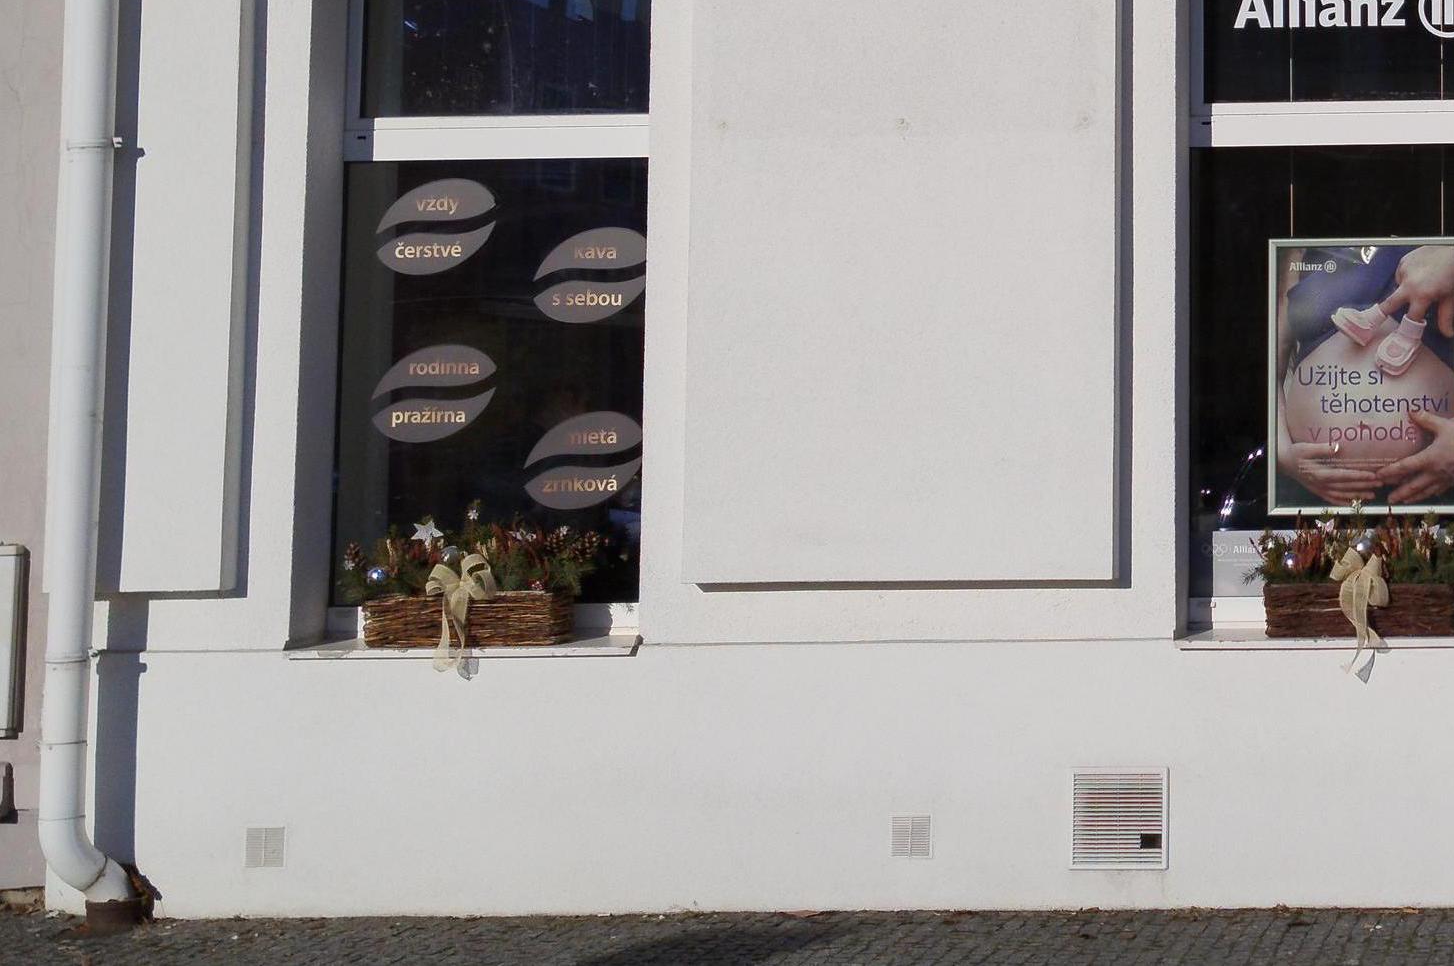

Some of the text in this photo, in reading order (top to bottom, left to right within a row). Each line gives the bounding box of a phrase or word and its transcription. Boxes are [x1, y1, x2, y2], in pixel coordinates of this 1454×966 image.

[394, 241, 461, 259] čerstvé
[1289, 261, 1323, 272] Allianz
[552, 289, 622, 307] s sebou
[1298, 365, 1384, 390] Užijte si
[1320, 391, 1449, 414] těhotenství
[391, 404, 466, 428] pražírna
[1308, 426, 1322, 443] v
